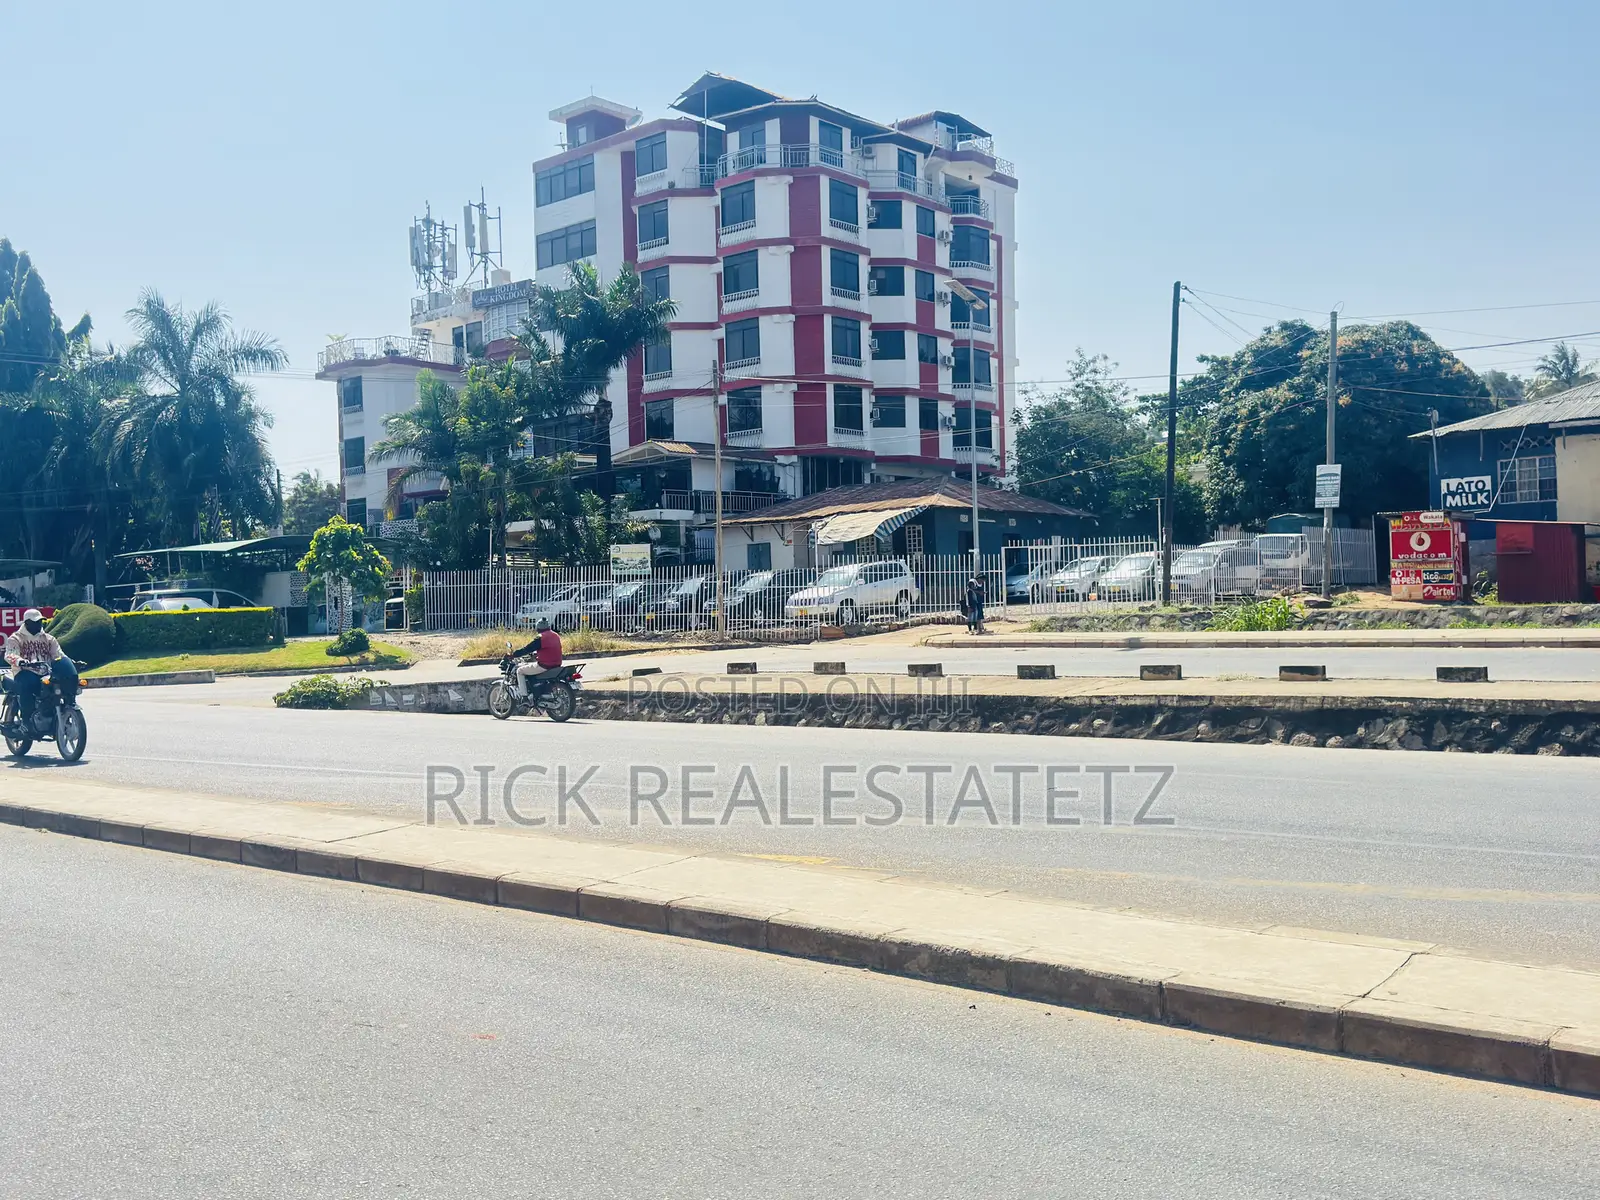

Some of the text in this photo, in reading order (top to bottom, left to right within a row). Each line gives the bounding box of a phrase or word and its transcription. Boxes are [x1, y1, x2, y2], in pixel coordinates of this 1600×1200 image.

[495, 283, 519, 295] HOTEL
[1446, 480, 1486, 493] LATO
[1391, 576, 1421, 585] M-PESA
[1432, 587, 1455, 596] airtel
